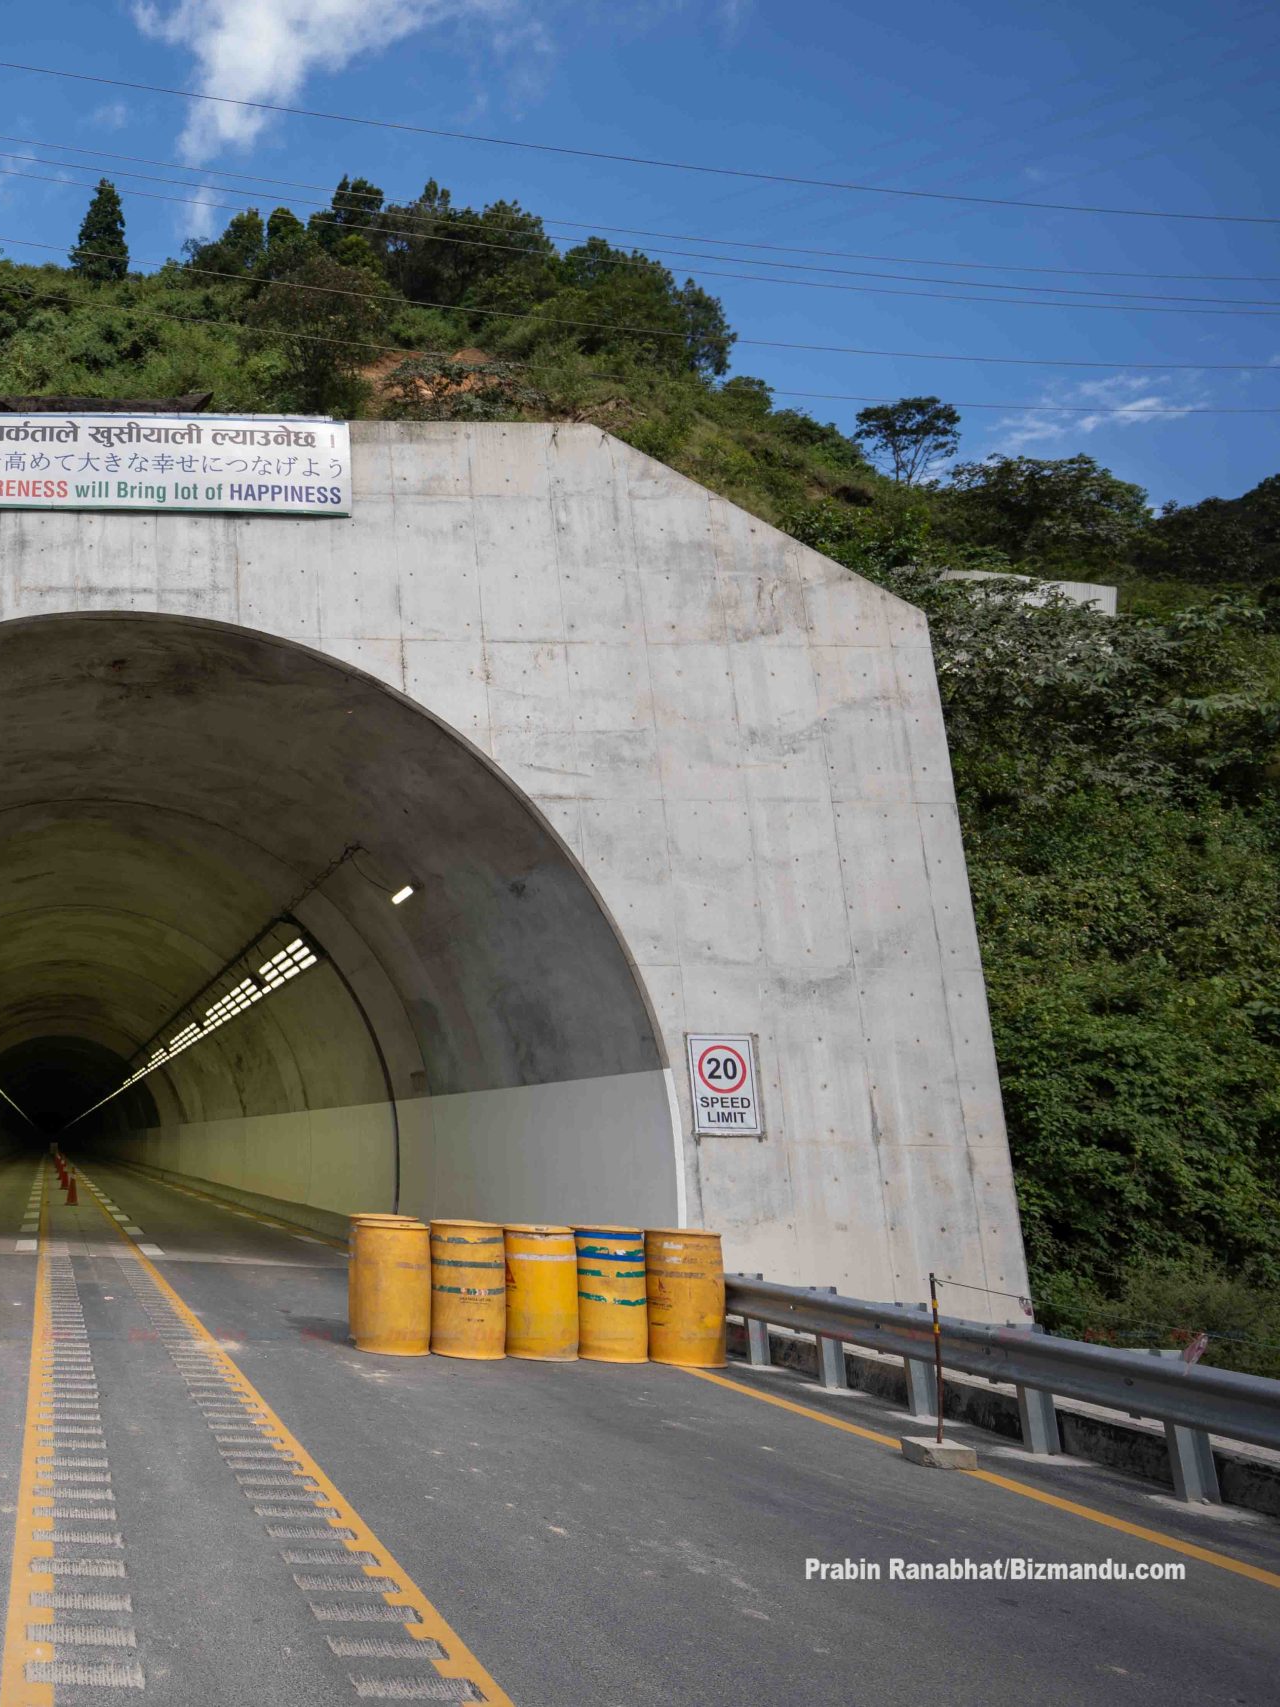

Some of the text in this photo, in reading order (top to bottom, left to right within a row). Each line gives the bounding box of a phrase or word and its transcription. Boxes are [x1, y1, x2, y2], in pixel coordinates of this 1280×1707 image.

[88, 422, 203, 447] खुसीयाली
[212, 425, 316, 448] ल्याउनेछ
[75, 481, 108, 498] will
[117, 482, 166, 502] Bring
[175, 483, 198, 500] lot
[205, 483, 222, 500] of
[230, 484, 341, 505] HAPPINESS
[707, 1058, 737, 1080] 20
[700, 1097, 750, 1108] SPEED
[707, 1112, 746, 1123] LIMIT
